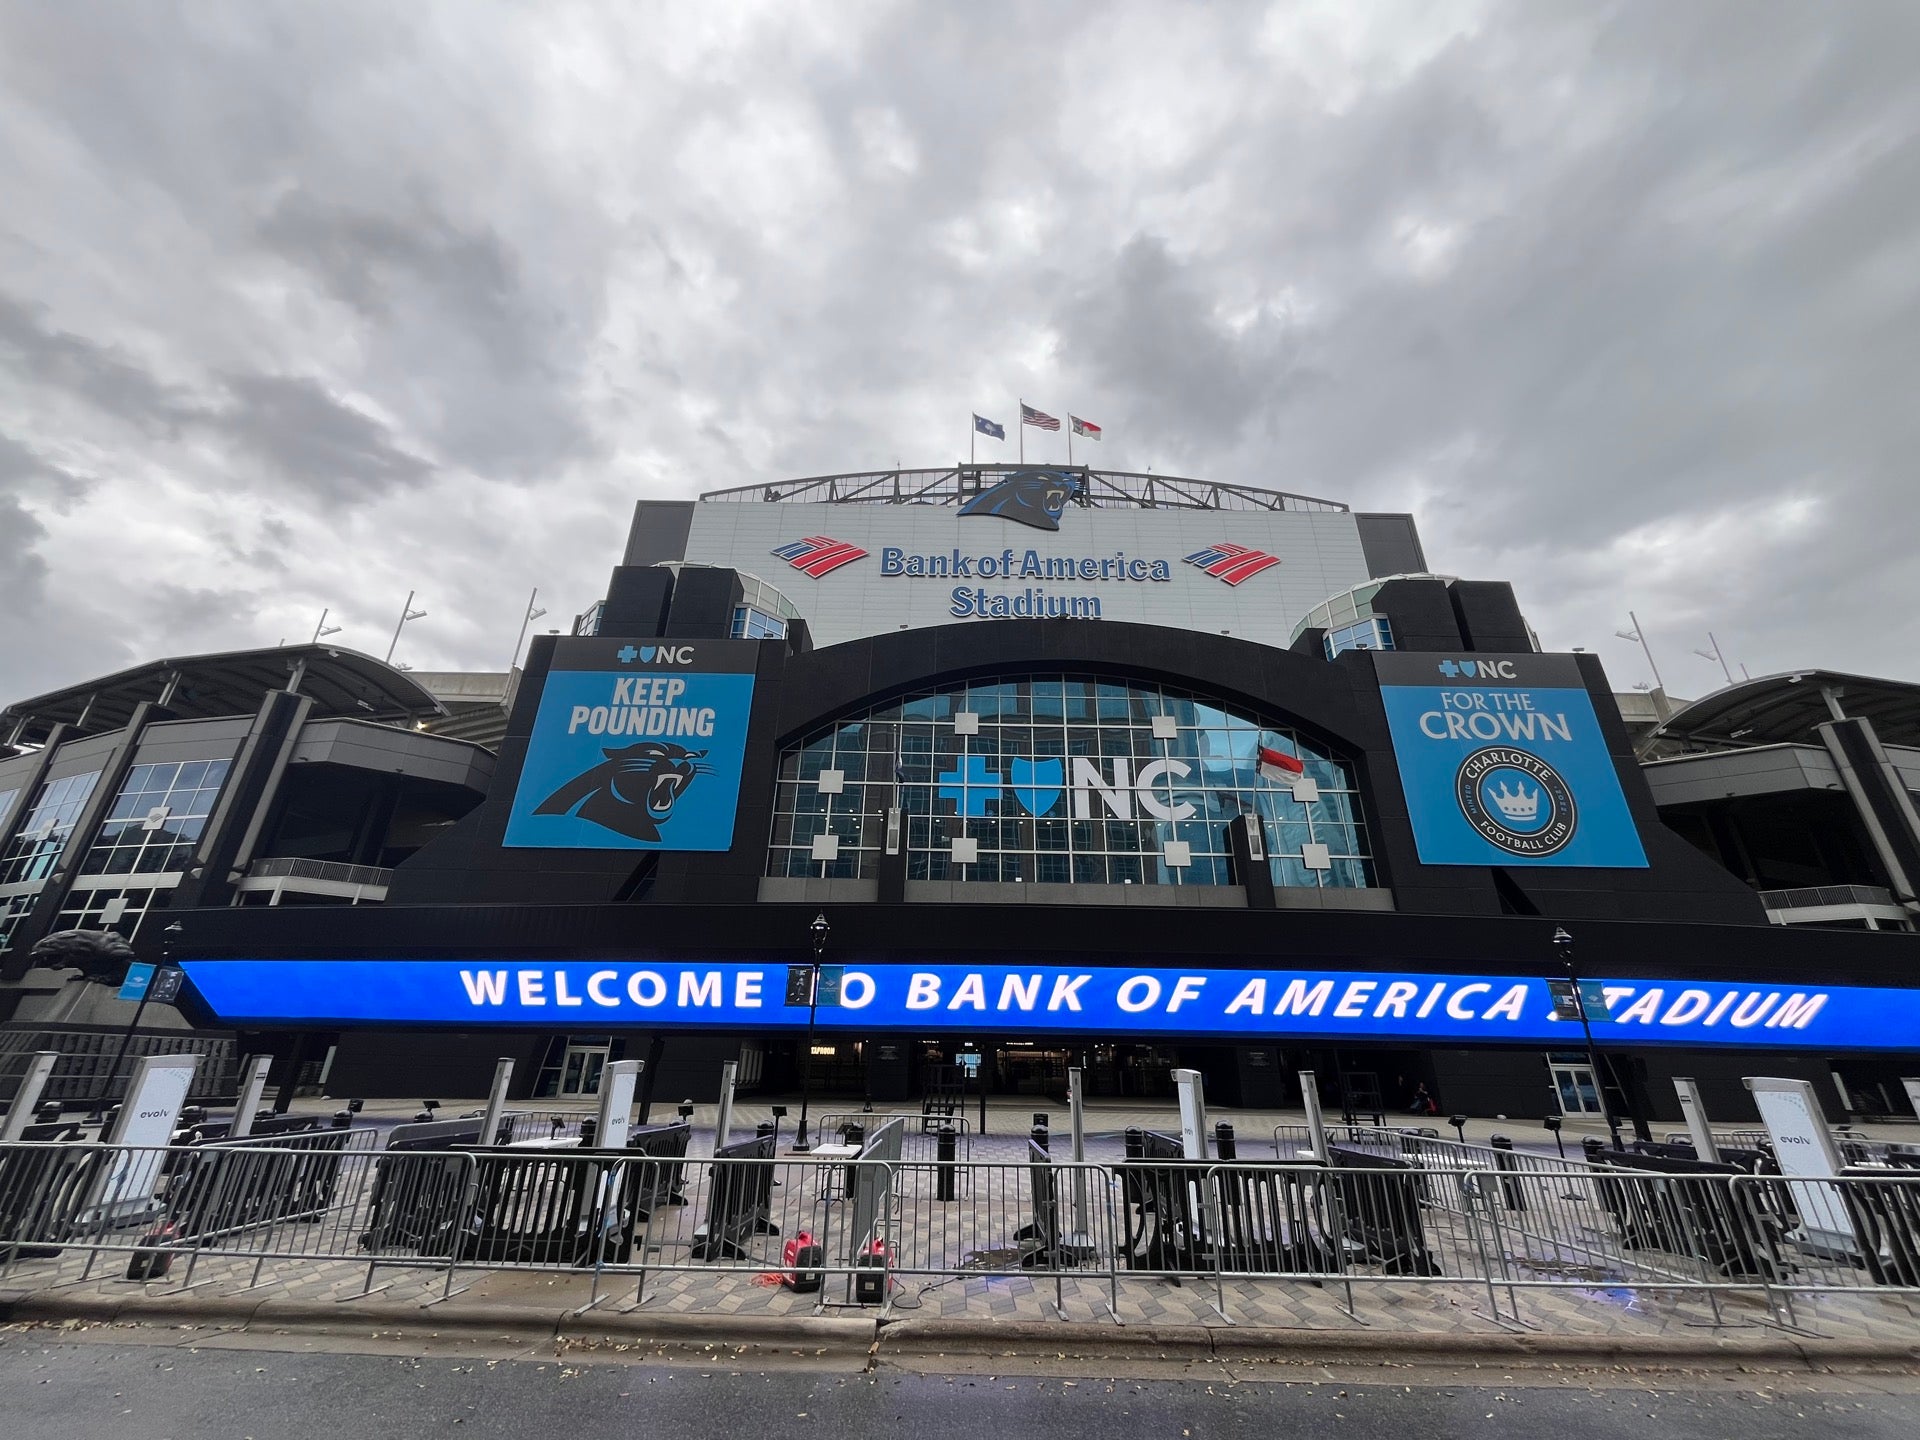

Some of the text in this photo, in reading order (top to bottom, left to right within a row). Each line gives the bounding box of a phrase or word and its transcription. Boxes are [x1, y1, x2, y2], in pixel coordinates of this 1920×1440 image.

[880, 547, 1172, 582] Bank of America
[949, 586, 1102, 618] Stadium
[656, 646, 695, 664] NC
[1476, 660, 1517, 679] NC
[612, 678, 685, 706] KEEP
[1440, 692, 1535, 711] FOR THE
[568, 706, 716, 737] POUNDING
[1419, 711, 1572, 741] CROWN
[1465, 751, 1551, 781] CHARLOTTE
[1072, 756, 1196, 821] NC
[1480, 820, 1567, 850] FOOTBALL CLUB
[459, 970, 764, 1008] WELCOME
[905, 973, 1093, 1011] BANK
[1116, 975, 1208, 1014] OF
[1224, 978, 1529, 1021] AMERICA
[1546, 986, 1829, 1029] TADIUM
[140, 1108, 171, 1119] evolv
[1780, 1134, 1811, 1146] evolv
